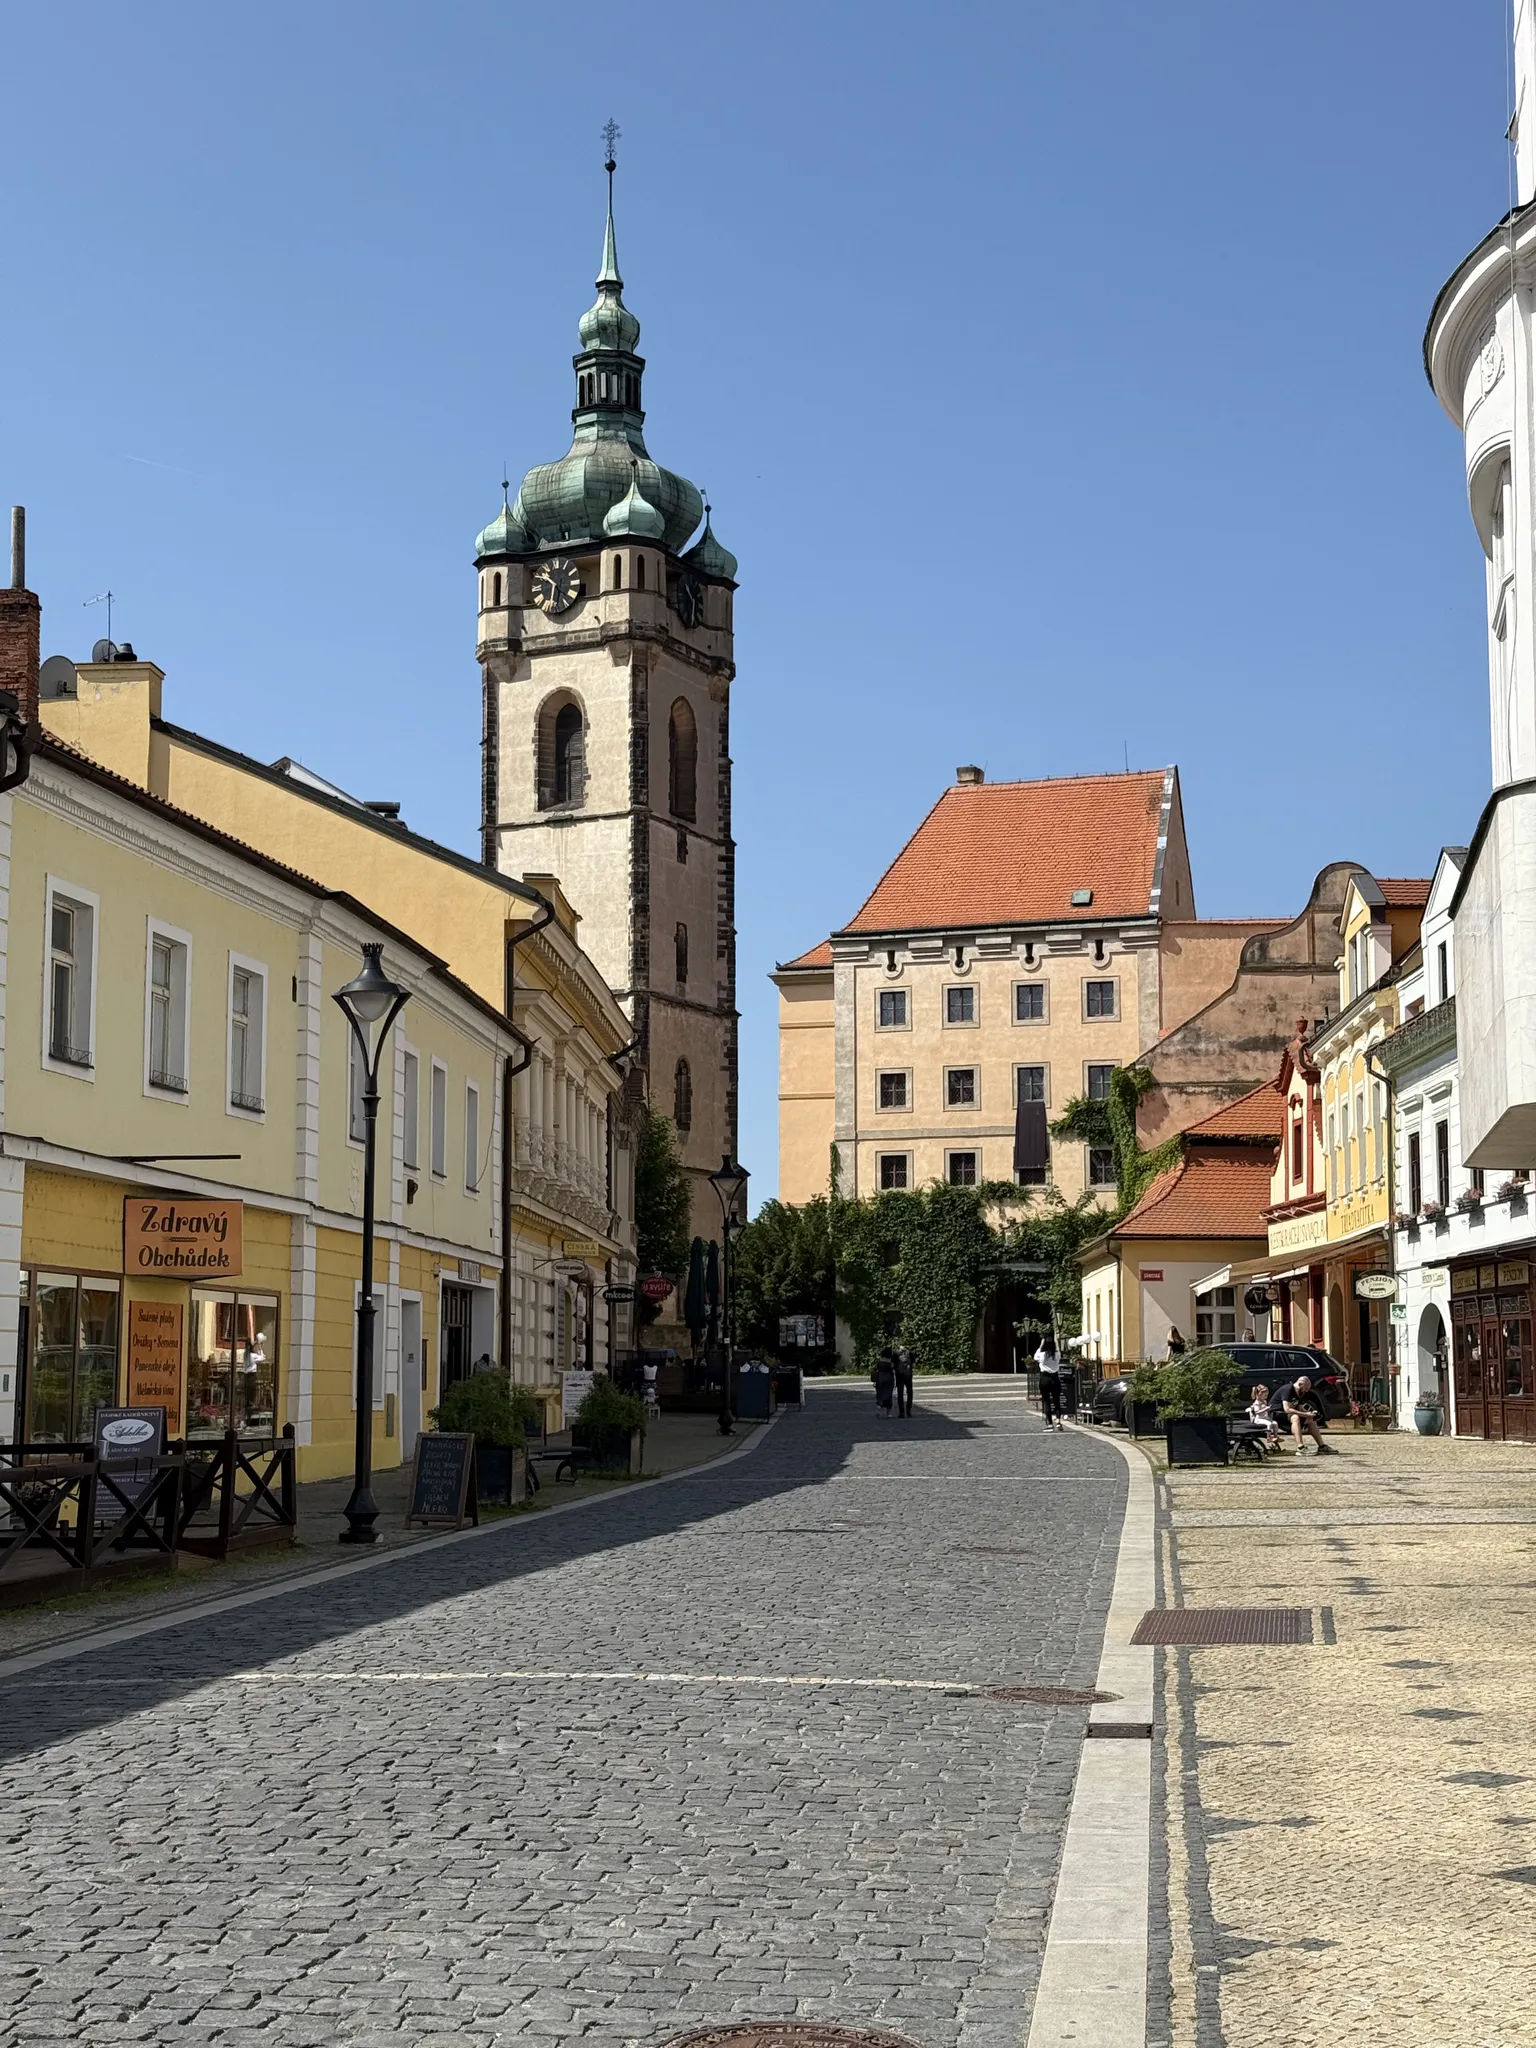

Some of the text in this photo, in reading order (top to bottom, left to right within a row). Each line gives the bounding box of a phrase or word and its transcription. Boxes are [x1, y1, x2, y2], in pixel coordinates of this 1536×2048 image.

[141, 1205, 228, 1242] Zdravý
[138, 1244, 230, 1268] Obchůdek
[1361, 1276, 1393, 1286] PENZION
